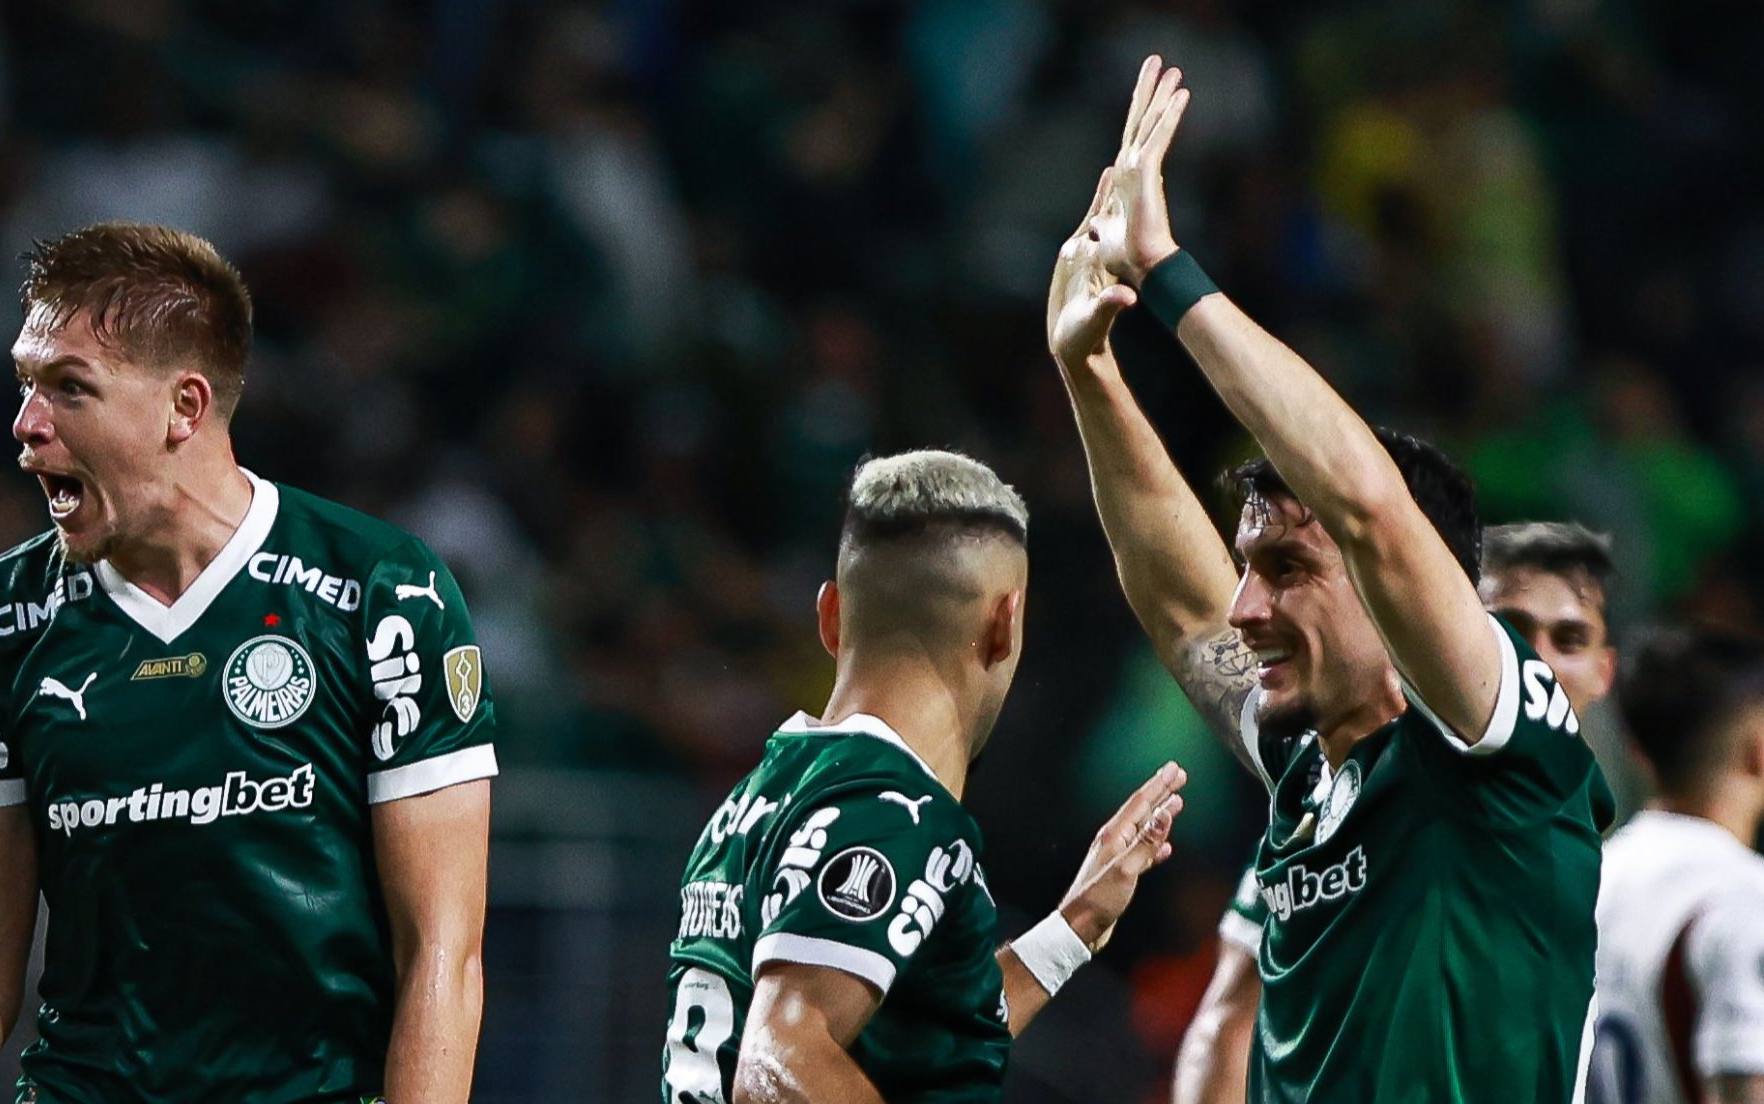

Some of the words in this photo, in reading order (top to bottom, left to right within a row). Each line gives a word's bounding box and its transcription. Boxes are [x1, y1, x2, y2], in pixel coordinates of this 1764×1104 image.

[248, 552, 361, 612] CIMED
[138, 660, 182, 677] AVANTI
[229, 675, 310, 723] PALMEIRAS
[49, 763, 316, 837] sportingbet
[677, 881, 744, 939] NDREAS
